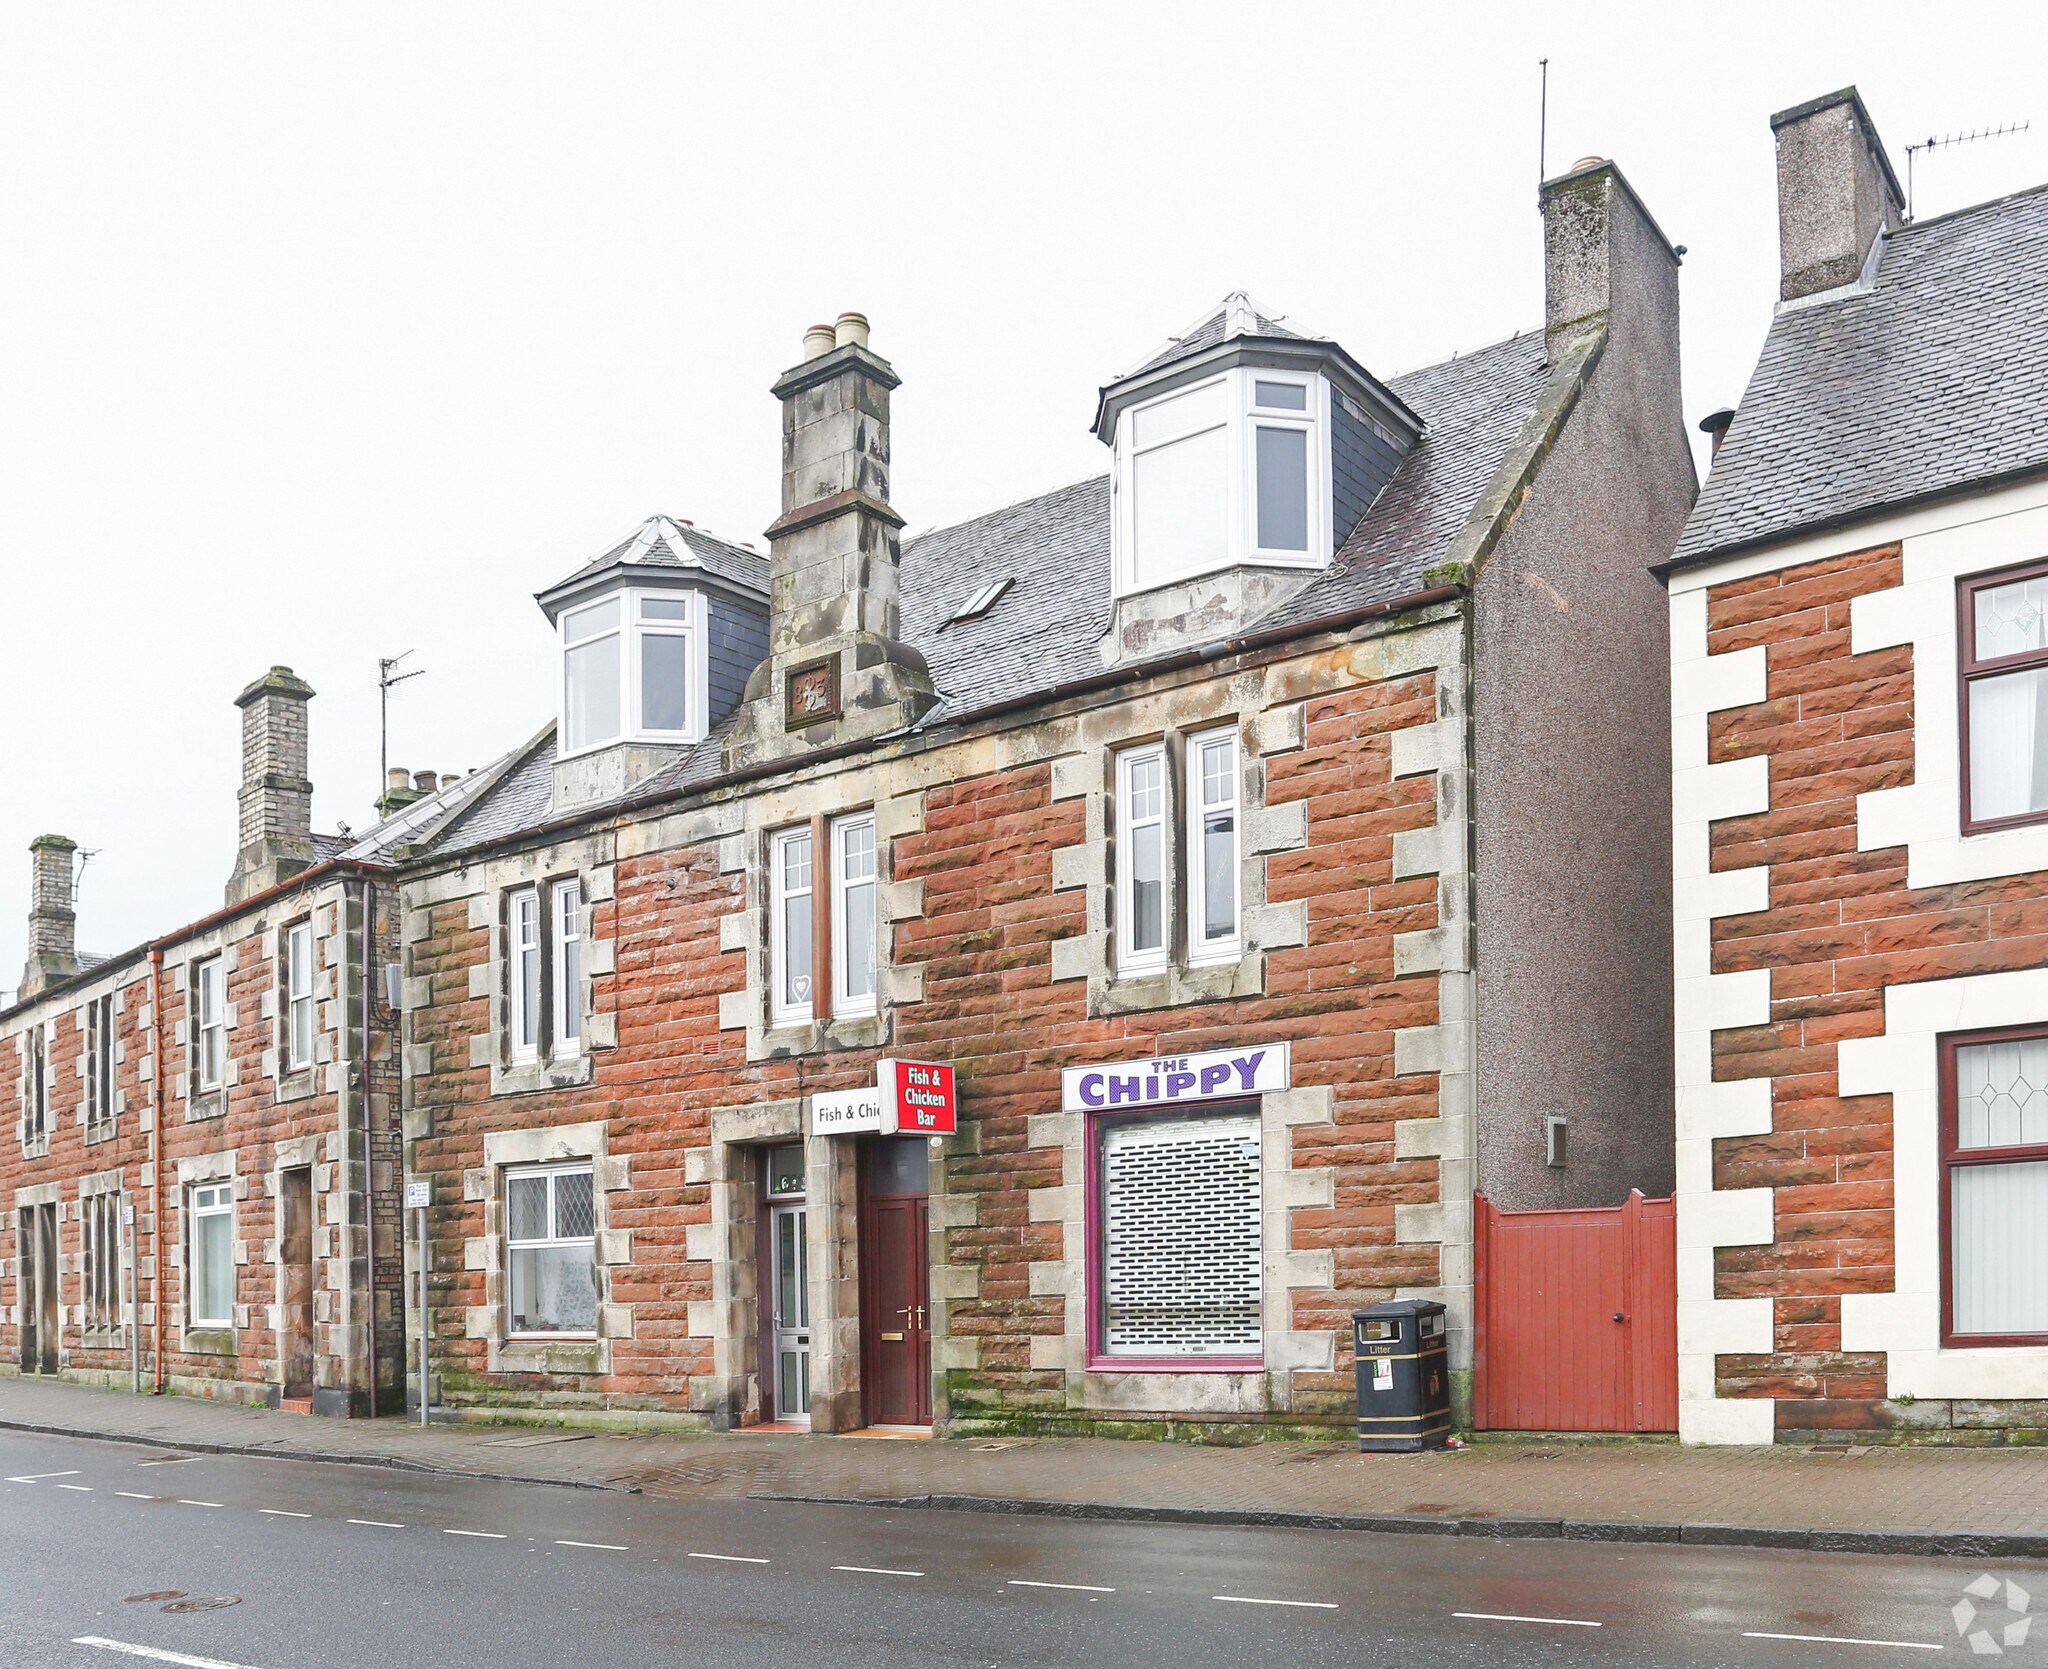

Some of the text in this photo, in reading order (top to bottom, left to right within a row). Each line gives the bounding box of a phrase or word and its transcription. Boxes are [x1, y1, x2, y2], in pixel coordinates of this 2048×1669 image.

[1151, 1058, 1188, 1073] THE
[908, 1067, 941, 1086] Fish &
[1079, 1051, 1266, 1106] CHIPPY
[905, 1088, 946, 1107] Chicken
[819, 1107, 842, 1122] Fish
[846, 1105, 855, 1120] &
[916, 1109, 936, 1126] Bar
[1370, 1346, 1391, 1354] Litter
